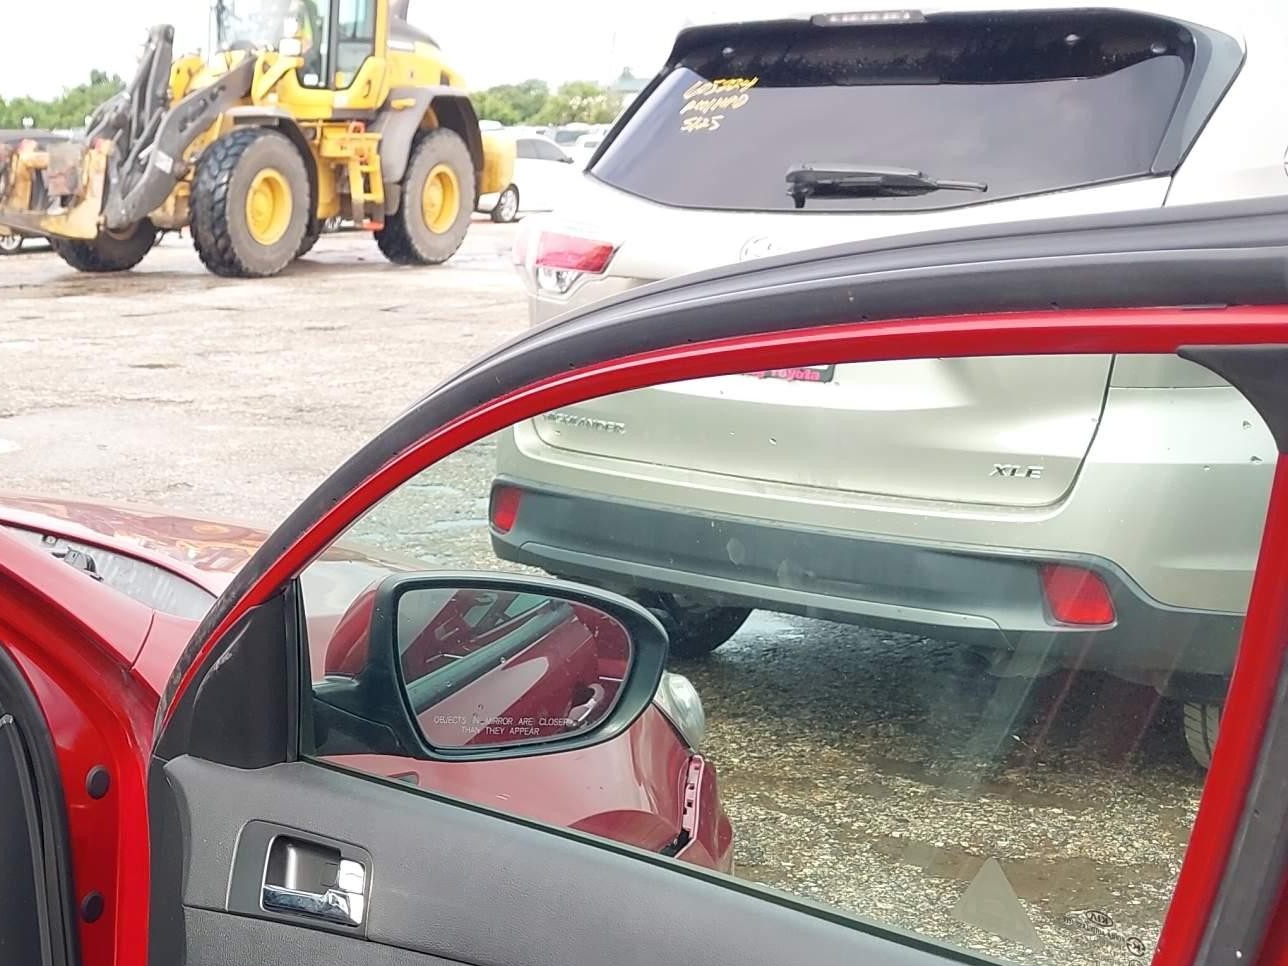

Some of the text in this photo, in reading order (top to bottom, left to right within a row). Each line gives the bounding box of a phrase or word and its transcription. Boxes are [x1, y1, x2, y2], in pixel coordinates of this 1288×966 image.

[988, 463, 1044, 479] XLE
[433, 715, 466, 725] OBJECTS
[486, 716, 513, 725] MIRROR
[518, 717, 533, 726] ARE
[538, 717, 569, 726] CLOSER
[462, 726, 540, 736] THAN THEY APPEAR
